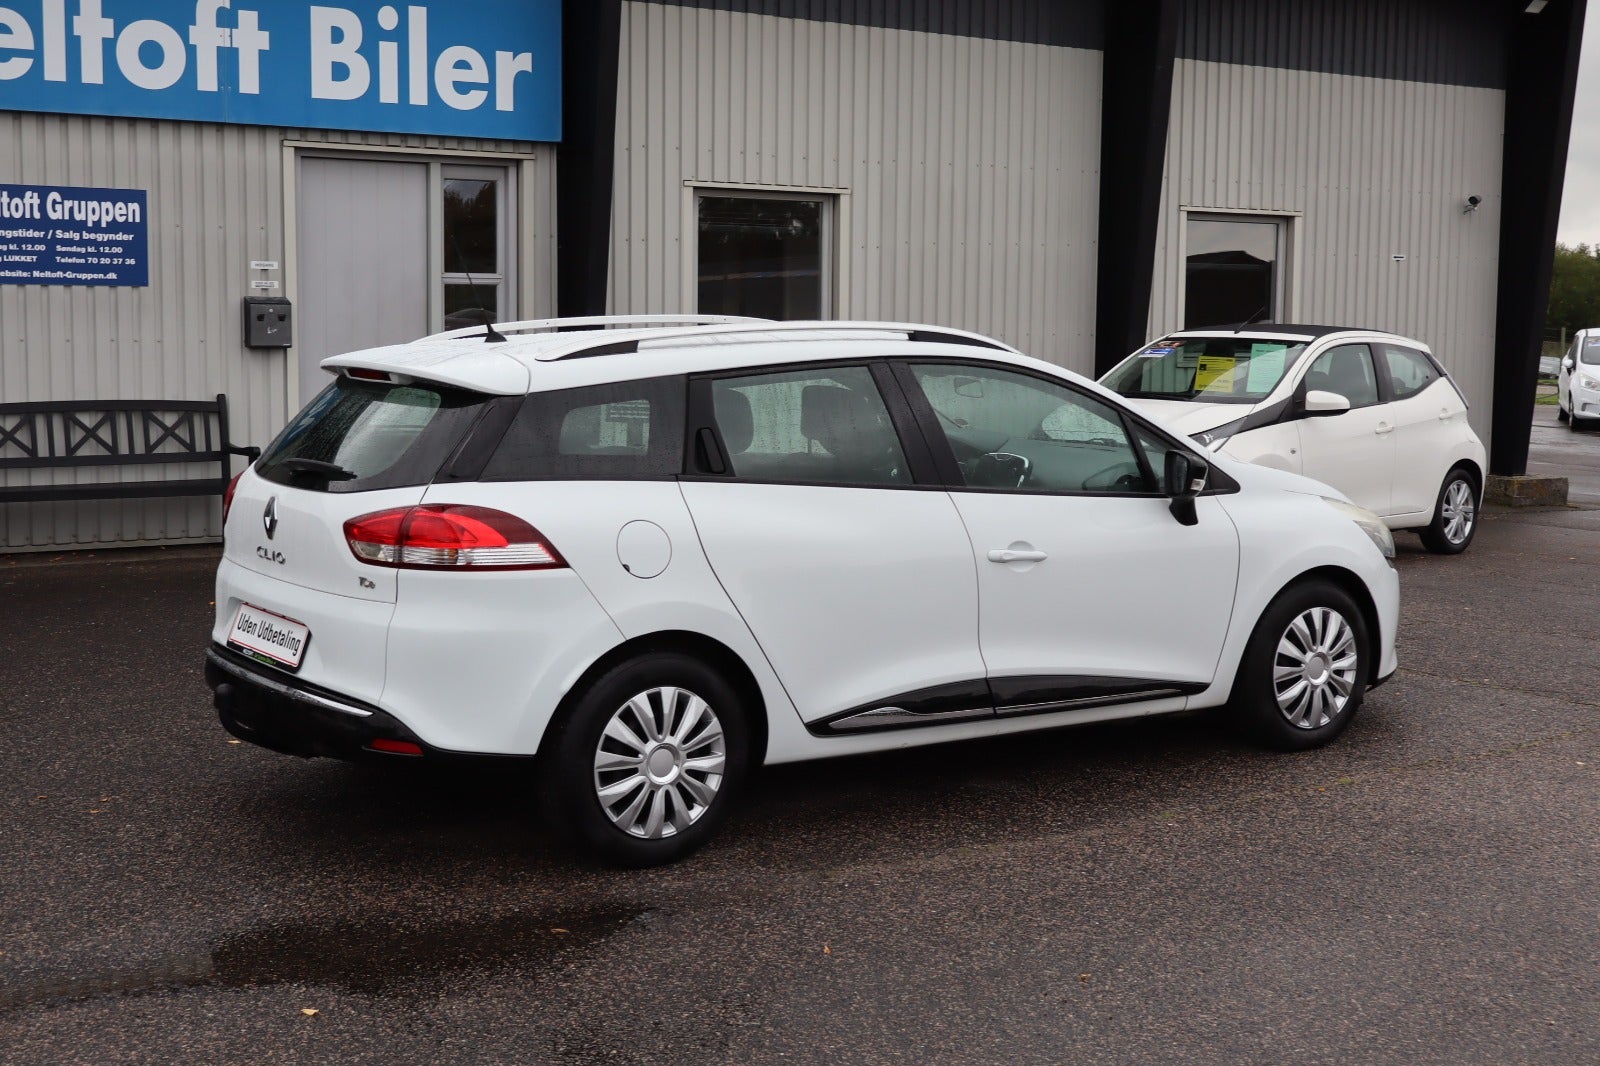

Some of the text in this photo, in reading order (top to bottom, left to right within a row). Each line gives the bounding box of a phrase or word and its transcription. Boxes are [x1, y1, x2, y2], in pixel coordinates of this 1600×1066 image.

[310, 5, 533, 112] Biler
[0, 190, 141, 228] toft Gruppen
[55, 229, 80, 241] Salg
[82, 230, 135, 242] begynder
[21, 244, 46, 252] 12.00
[55, 244, 86, 254] Søndag
[99, 246, 123, 254] 12.00
[3, 254, 38, 262] LUKKET
[55, 256, 86, 264] Telefon
[100, 257, 111, 265] 20
[256, 545, 286, 565] CLIO
[237, 612, 257, 636] Uden
[257, 620, 302, 657] Udbetaling
